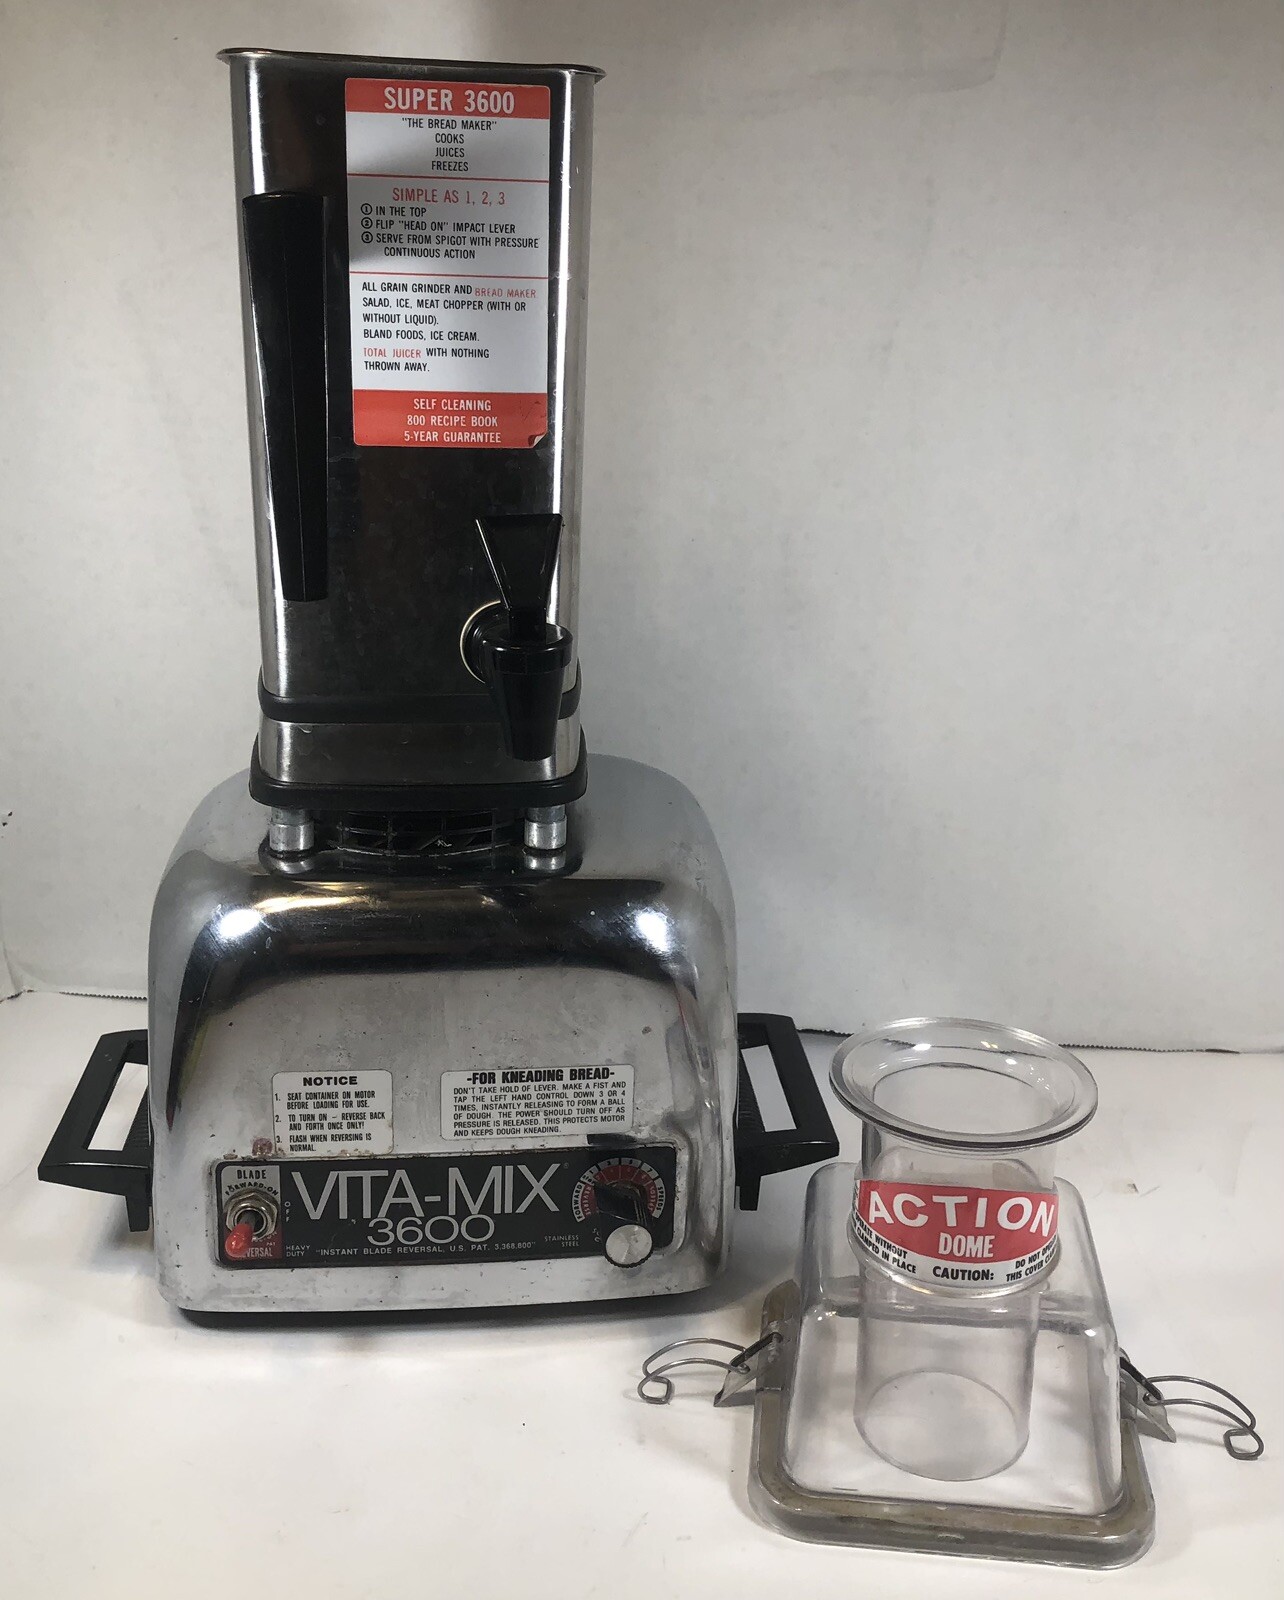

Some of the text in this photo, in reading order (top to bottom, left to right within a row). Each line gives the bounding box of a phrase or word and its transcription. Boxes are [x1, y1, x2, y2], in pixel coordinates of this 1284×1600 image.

[384, 87, 515, 114] SUPER 3600
[428, 119, 457, 129] BREAD
[435, 133, 464, 144] COOKS
[435, 148, 465, 157] JUICES
[431, 161, 469, 171] FREEZES
[392, 188, 438, 203] SIMPLE
[444, 191, 459, 203] AS
[498, 192, 505, 205] 3
[376, 206, 426, 217] IN THE TOP
[376, 220, 394, 229] FLIP
[453, 223, 485, 233] IMPACT
[489, 223, 516, 234] LEVER
[376, 234, 539, 248] SERVE FROM SPIGOT WITH PRESSURE
[384, 247, 475, 259] CONTINUOUS ACTION
[362, 282, 536, 298] ALL GRAIN GRINDER AND BREAD MAKER
[416, 300, 439, 309] MEAT
[443, 301, 483, 310] CHOPPER
[487, 301, 511, 312] (WITH
[515, 302, 526, 311] OR
[363, 313, 439, 326] WITHOUT LIQUID).
[363, 329, 392, 339] BLAND
[430, 331, 444, 340] ICE
[448, 332, 479, 341] CREAM.
[364, 348, 490, 359] TOTAL JUICER WITH NOTHING
[364, 361, 430, 372] THROWN AWAY.
[414, 399, 491, 411] SELF CLEANING
[407, 415, 498, 427] 800 RECIPE BOOK
[404, 432, 501, 443] 5-YEAR GUARANTEE
[303, 1076, 358, 1086] NOTICE
[502, 1069, 564, 1083] KNEADING
[479, 1086, 497, 1094] TAKE
[534, 1084, 558, 1092] LEVER.
[288, 1093, 302, 1101] SEAT
[305, 1092, 339, 1100] CONTAINER
[343, 1091, 351, 1099] ON
[536, 1092, 568, 1100] CONTROL
[287, 1100, 369, 1110] BEFORE LOADING FOR USE.
[482, 1102, 521, 1110] INSTANTLY
[524, 1100, 564, 1109] RELEASING
[608, 1098, 625, 1106] BALL
[288, 1114, 295, 1123] TO
[299, 1114, 315, 1122] TURN
[342, 1112, 366, 1121] REVERSE
[516, 1110, 540, 1118] POWER
[544, 1108, 572, 1116] SHOULD
[289, 1123, 301, 1131] AND
[305, 1123, 324, 1131] FORTH
[328, 1122, 343, 1130] ONCE
[454, 1120, 490, 1128] PRESSURE
[502, 1118, 540, 1126] RELEASED.
[562, 1116, 598, 1124] PROTECTS
[472, 1128, 494, 1136] KEEPS
[524, 1126, 562, 1134] KNEADING.
[289, 1133, 371, 1143] FLASH WHEN REVERSING IS
[290, 1144, 316, 1152] NORMAL.
[237, 1170, 266, 1179] BLADE
[291, 1163, 561, 1220] VITA-MIX
[574, 1184, 584, 1220] FORWARD
[869, 1191, 1055, 1237] ACTION
[367, 1214, 495, 1246] 3600
[544, 1234, 579, 1242] STAINLESS
[363, 1247, 392, 1255] BLADE
[875, 1235, 908, 1259] WITHOUT
[938, 1232, 995, 1258] DOME
[882, 1250, 890, 1261] IN
[892, 1256, 916, 1273] PLACE
[1015, 1259, 1026, 1269] DO
[1028, 1250, 1041, 1265] NOT
[932, 1266, 995, 1281] CAUTION:
[1006, 1260, 1044, 1282] THIS COVER
